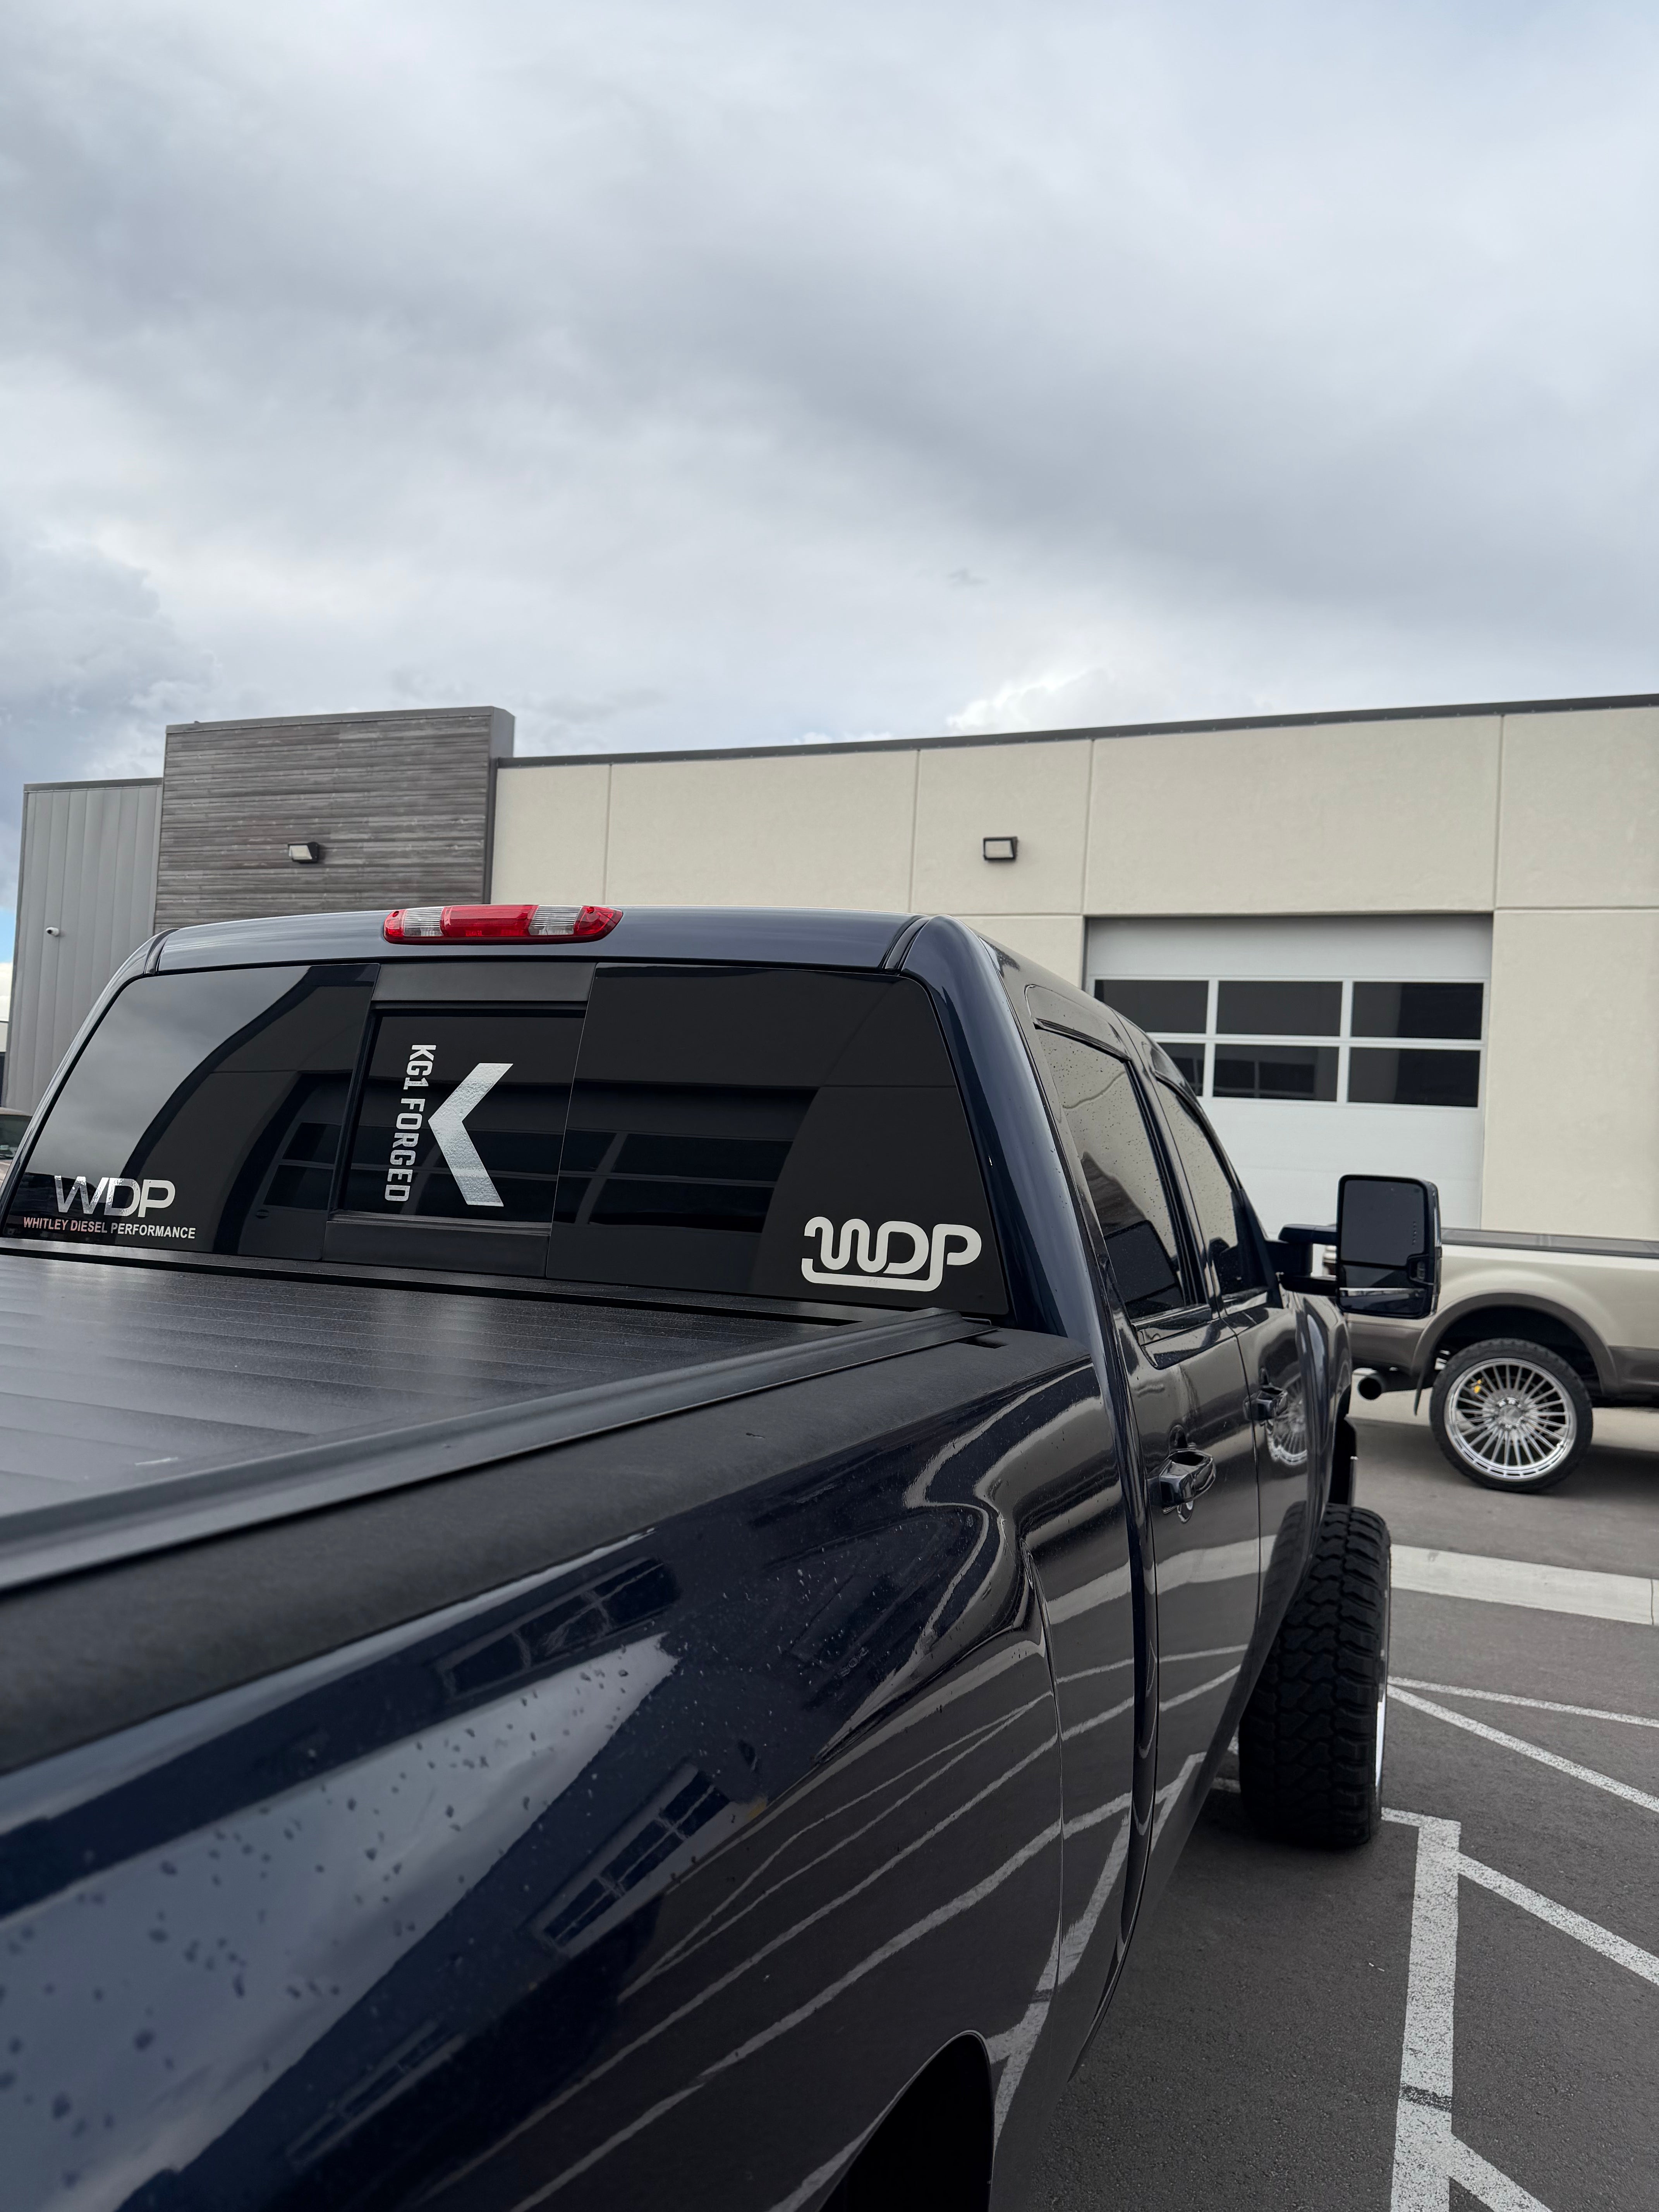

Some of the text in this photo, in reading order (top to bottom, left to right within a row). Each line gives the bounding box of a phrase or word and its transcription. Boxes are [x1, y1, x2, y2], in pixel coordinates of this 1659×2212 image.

[385, 1044, 436, 1201] KG1 FORGED
[54, 1175, 175, 1218] WDP
[24, 1217, 196, 1239] WHITLEY DIESEL PERFORMANCE
